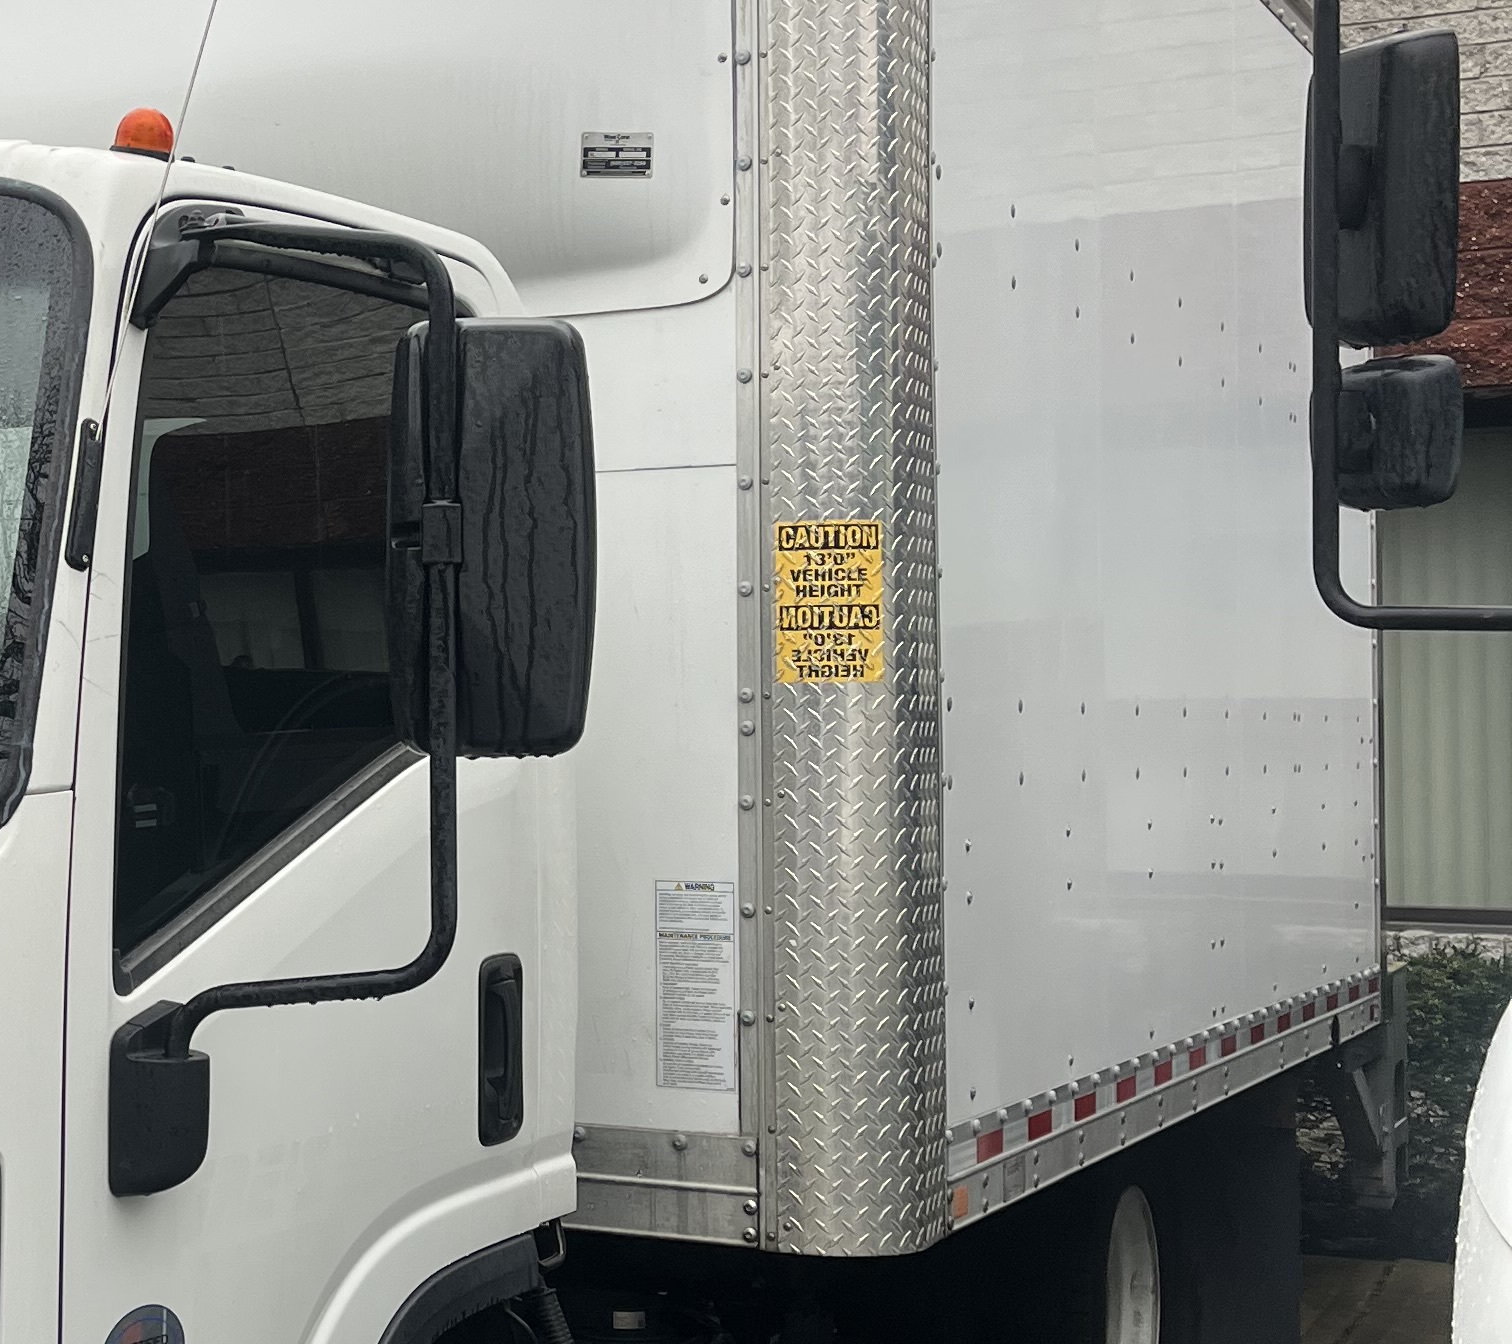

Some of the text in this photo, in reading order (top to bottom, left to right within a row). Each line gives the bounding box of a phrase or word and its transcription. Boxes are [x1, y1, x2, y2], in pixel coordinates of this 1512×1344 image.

[780, 525, 878, 550] CAUTION
[790, 567, 868, 583] VEHICLE
[795, 583, 864, 598] HEIGHT
[685, 883, 715, 891] WARNING
